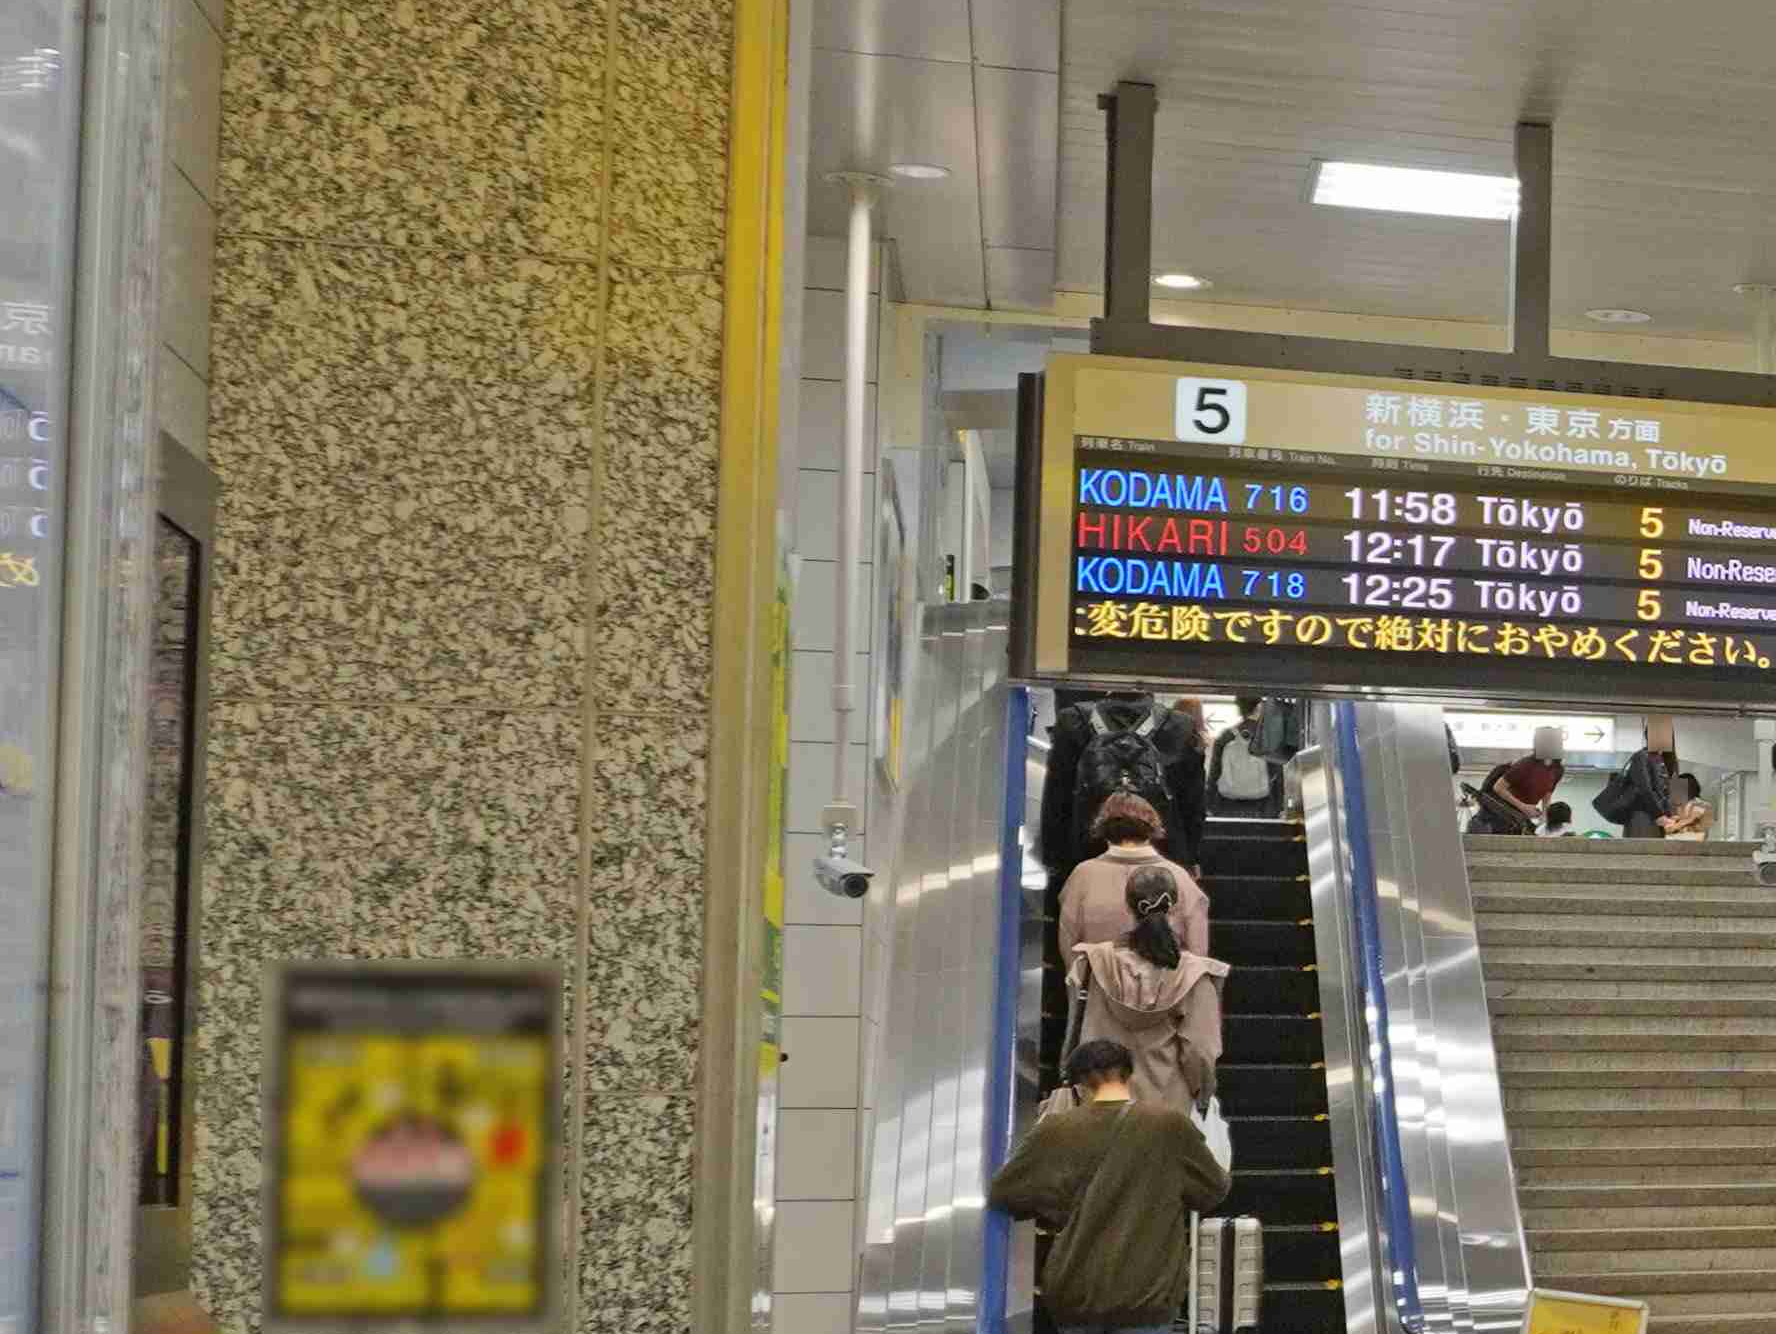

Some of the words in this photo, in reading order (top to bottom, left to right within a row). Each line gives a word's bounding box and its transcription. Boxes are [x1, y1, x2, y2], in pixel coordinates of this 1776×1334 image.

[1192, 387, 1230, 434] 5
[1365, 429, 1403, 451] for
[1413, 431, 1638, 470] Shin-Yokohama,
[1646, 448, 1727, 477] Tōkyō
[1080, 469, 1228, 513] KODAMA
[1245, 484, 1308, 513] 716
[1344, 488, 1456, 525] 11:58
[1476, 496, 1584, 533] Tōkyō
[1639, 507, 1664, 539] 5
[1077, 513, 1229, 556] HIKARI
[1243, 527, 1308, 555] 504
[1344, 531, 1455, 567] 12:17
[1475, 538, 1583, 576] Tōkyō
[1638, 549, 1664, 580] 5
[1077, 556, 1224, 598] KODAMA
[1242, 570, 1305, 599] 718
[1342, 574, 1453, 610] 12:25
[1474, 580, 1582, 618] Tōkyō
[1637, 590, 1662, 621] 5
[1074, 599, 1771, 668] 変危険ですので絶対におやめください。
